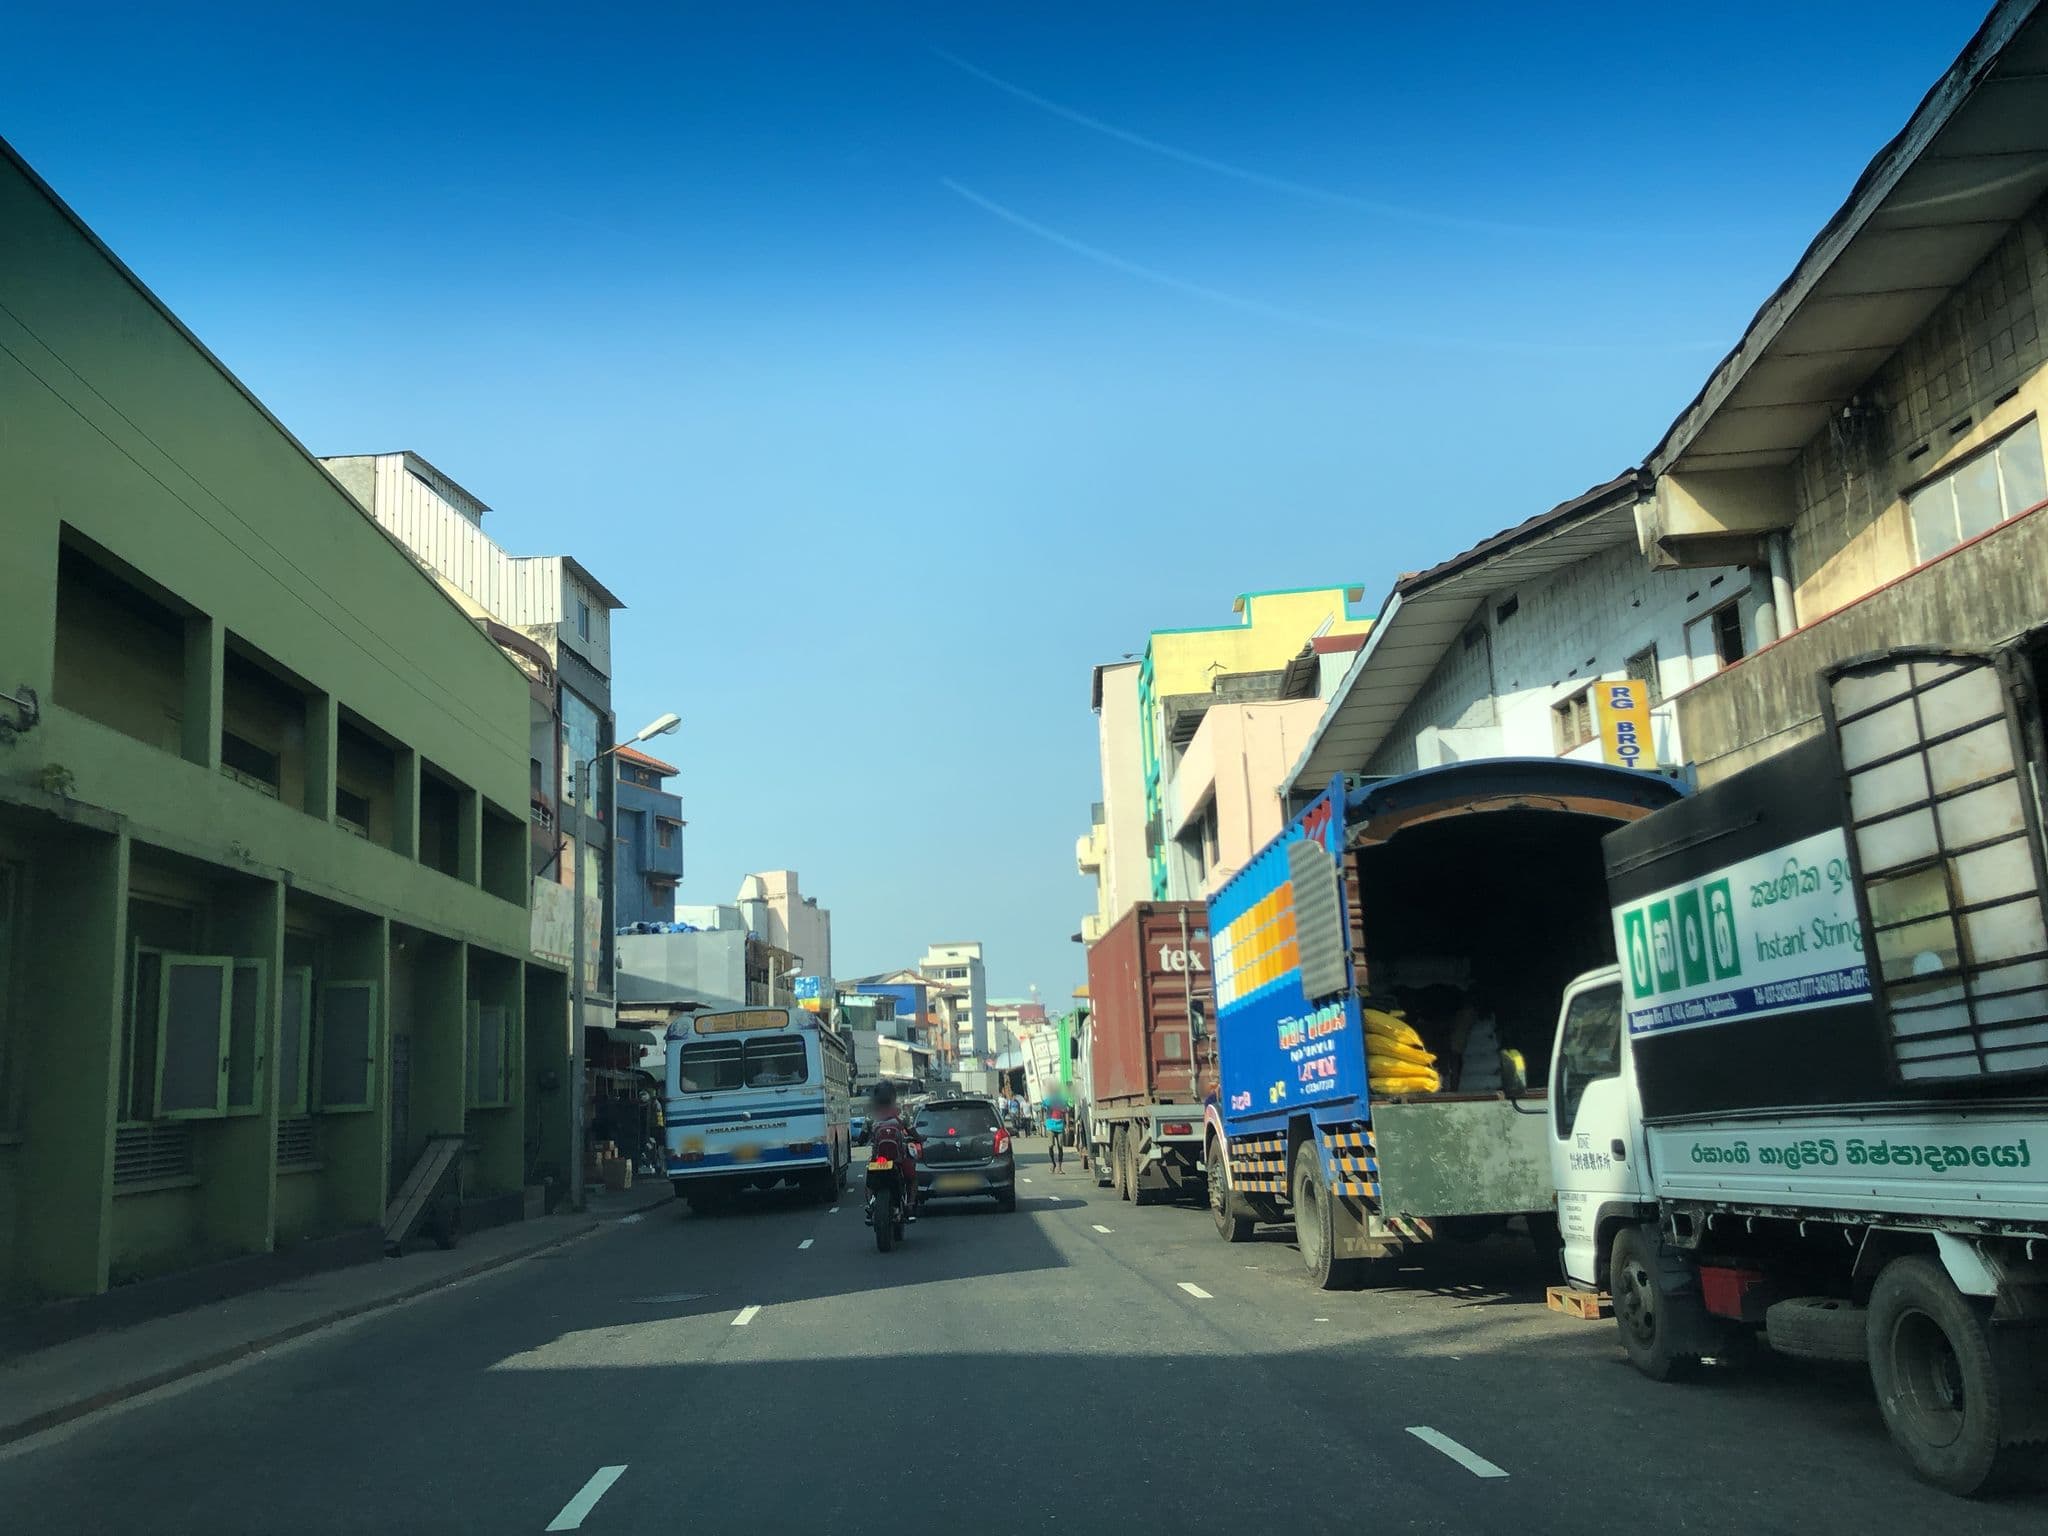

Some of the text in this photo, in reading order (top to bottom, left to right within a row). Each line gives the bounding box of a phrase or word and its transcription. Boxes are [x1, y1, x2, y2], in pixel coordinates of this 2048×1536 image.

[1610, 686, 1641, 767] RG BROT
[1158, 943, 1206, 973] tex
[1755, 925, 1808, 963] Instant
[1691, 1140, 1751, 1164] රසාංගි
[1845, 1137, 2031, 1173] නිෂ්පාදකයෝ
